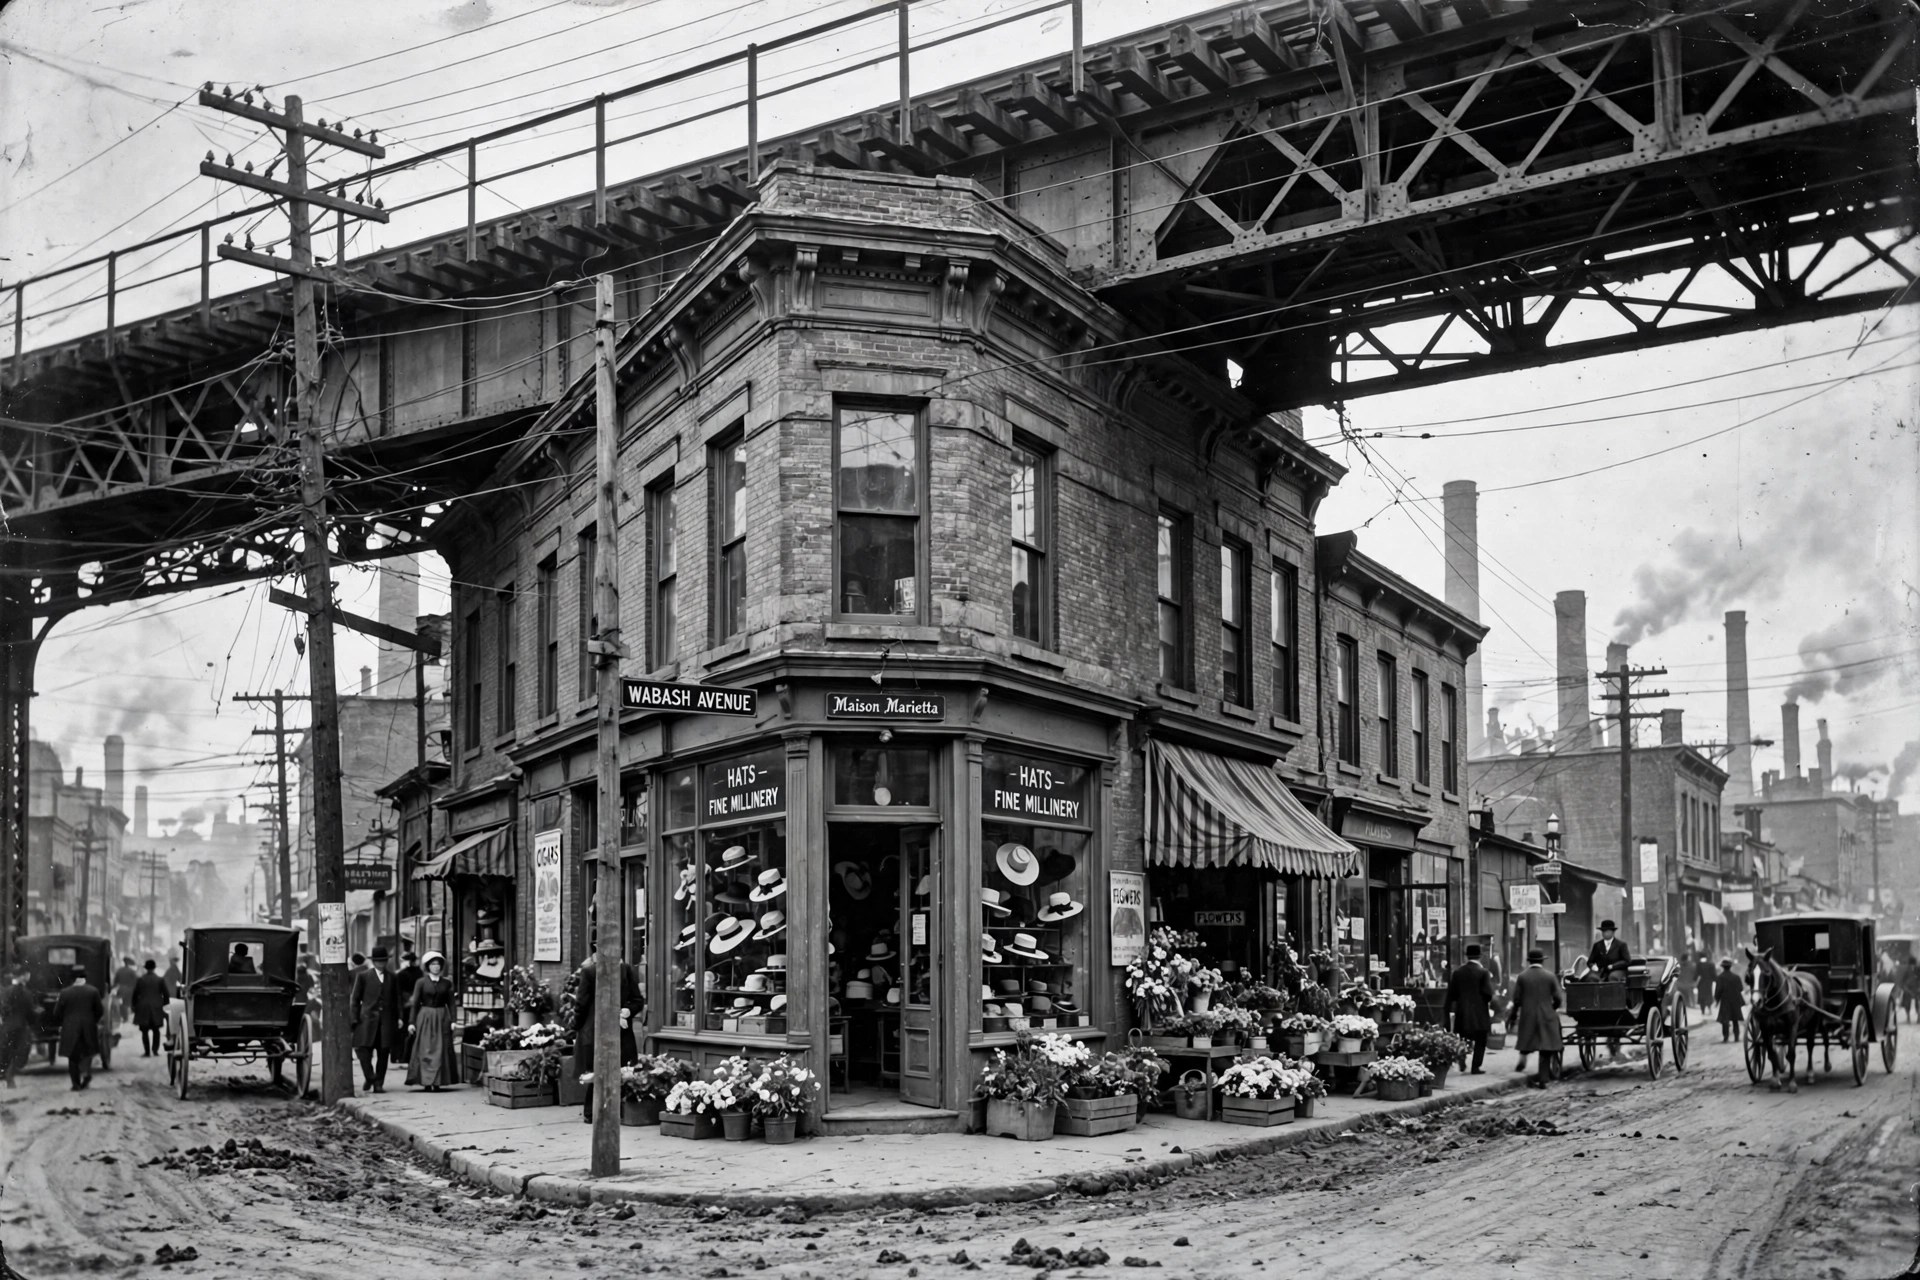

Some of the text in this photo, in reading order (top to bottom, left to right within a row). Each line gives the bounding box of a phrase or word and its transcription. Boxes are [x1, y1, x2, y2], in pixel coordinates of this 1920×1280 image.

[628, 685, 752, 711] WABASH AVENUE
[833, 696, 938, 714] Maison Marietta
[727, 764, 756, 788] HATS
[1020, 765, 1052, 790] HATS
[709, 786, 779, 816] FINE MILLINERY
[994, 789, 1080, 819] FINE MILLINERY
